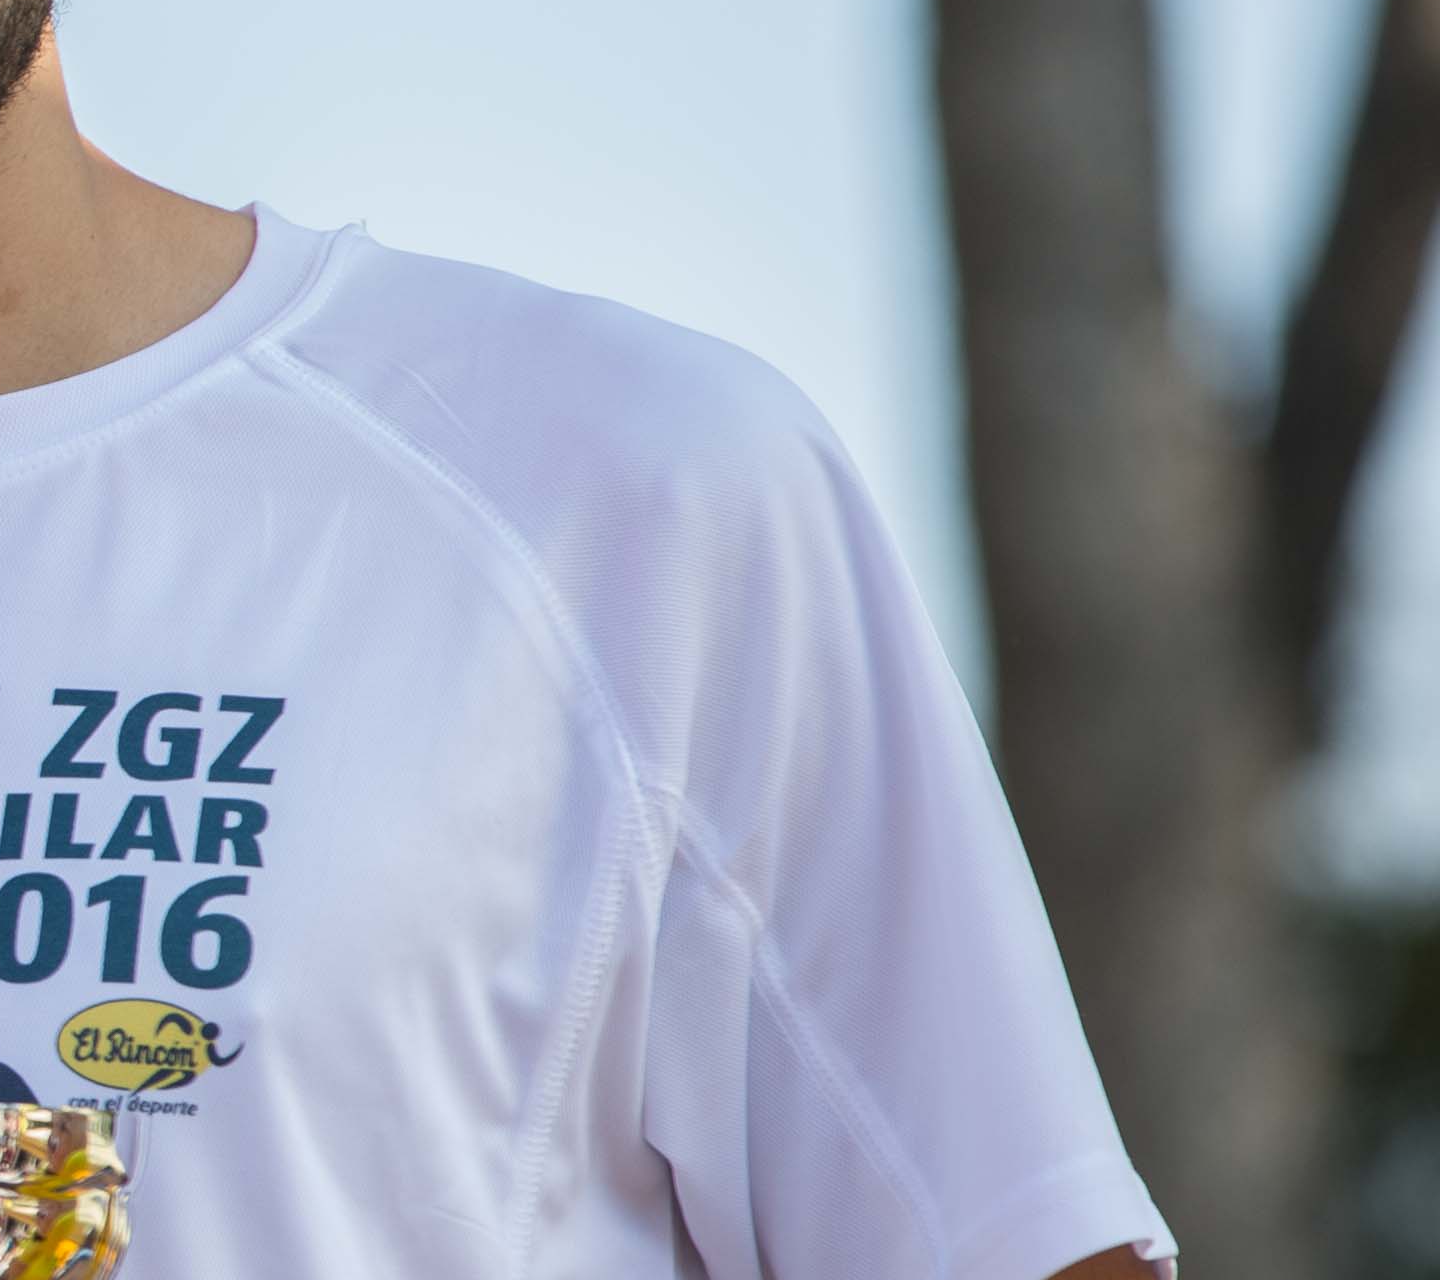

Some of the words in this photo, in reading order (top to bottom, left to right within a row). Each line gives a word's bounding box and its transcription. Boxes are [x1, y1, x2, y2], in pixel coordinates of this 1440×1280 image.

[39, 687, 287, 785] ZGZ
[73, 1027, 100, 1062] El
[105, 1095, 123, 1112] el
[127, 1096, 199, 1117] deporte
